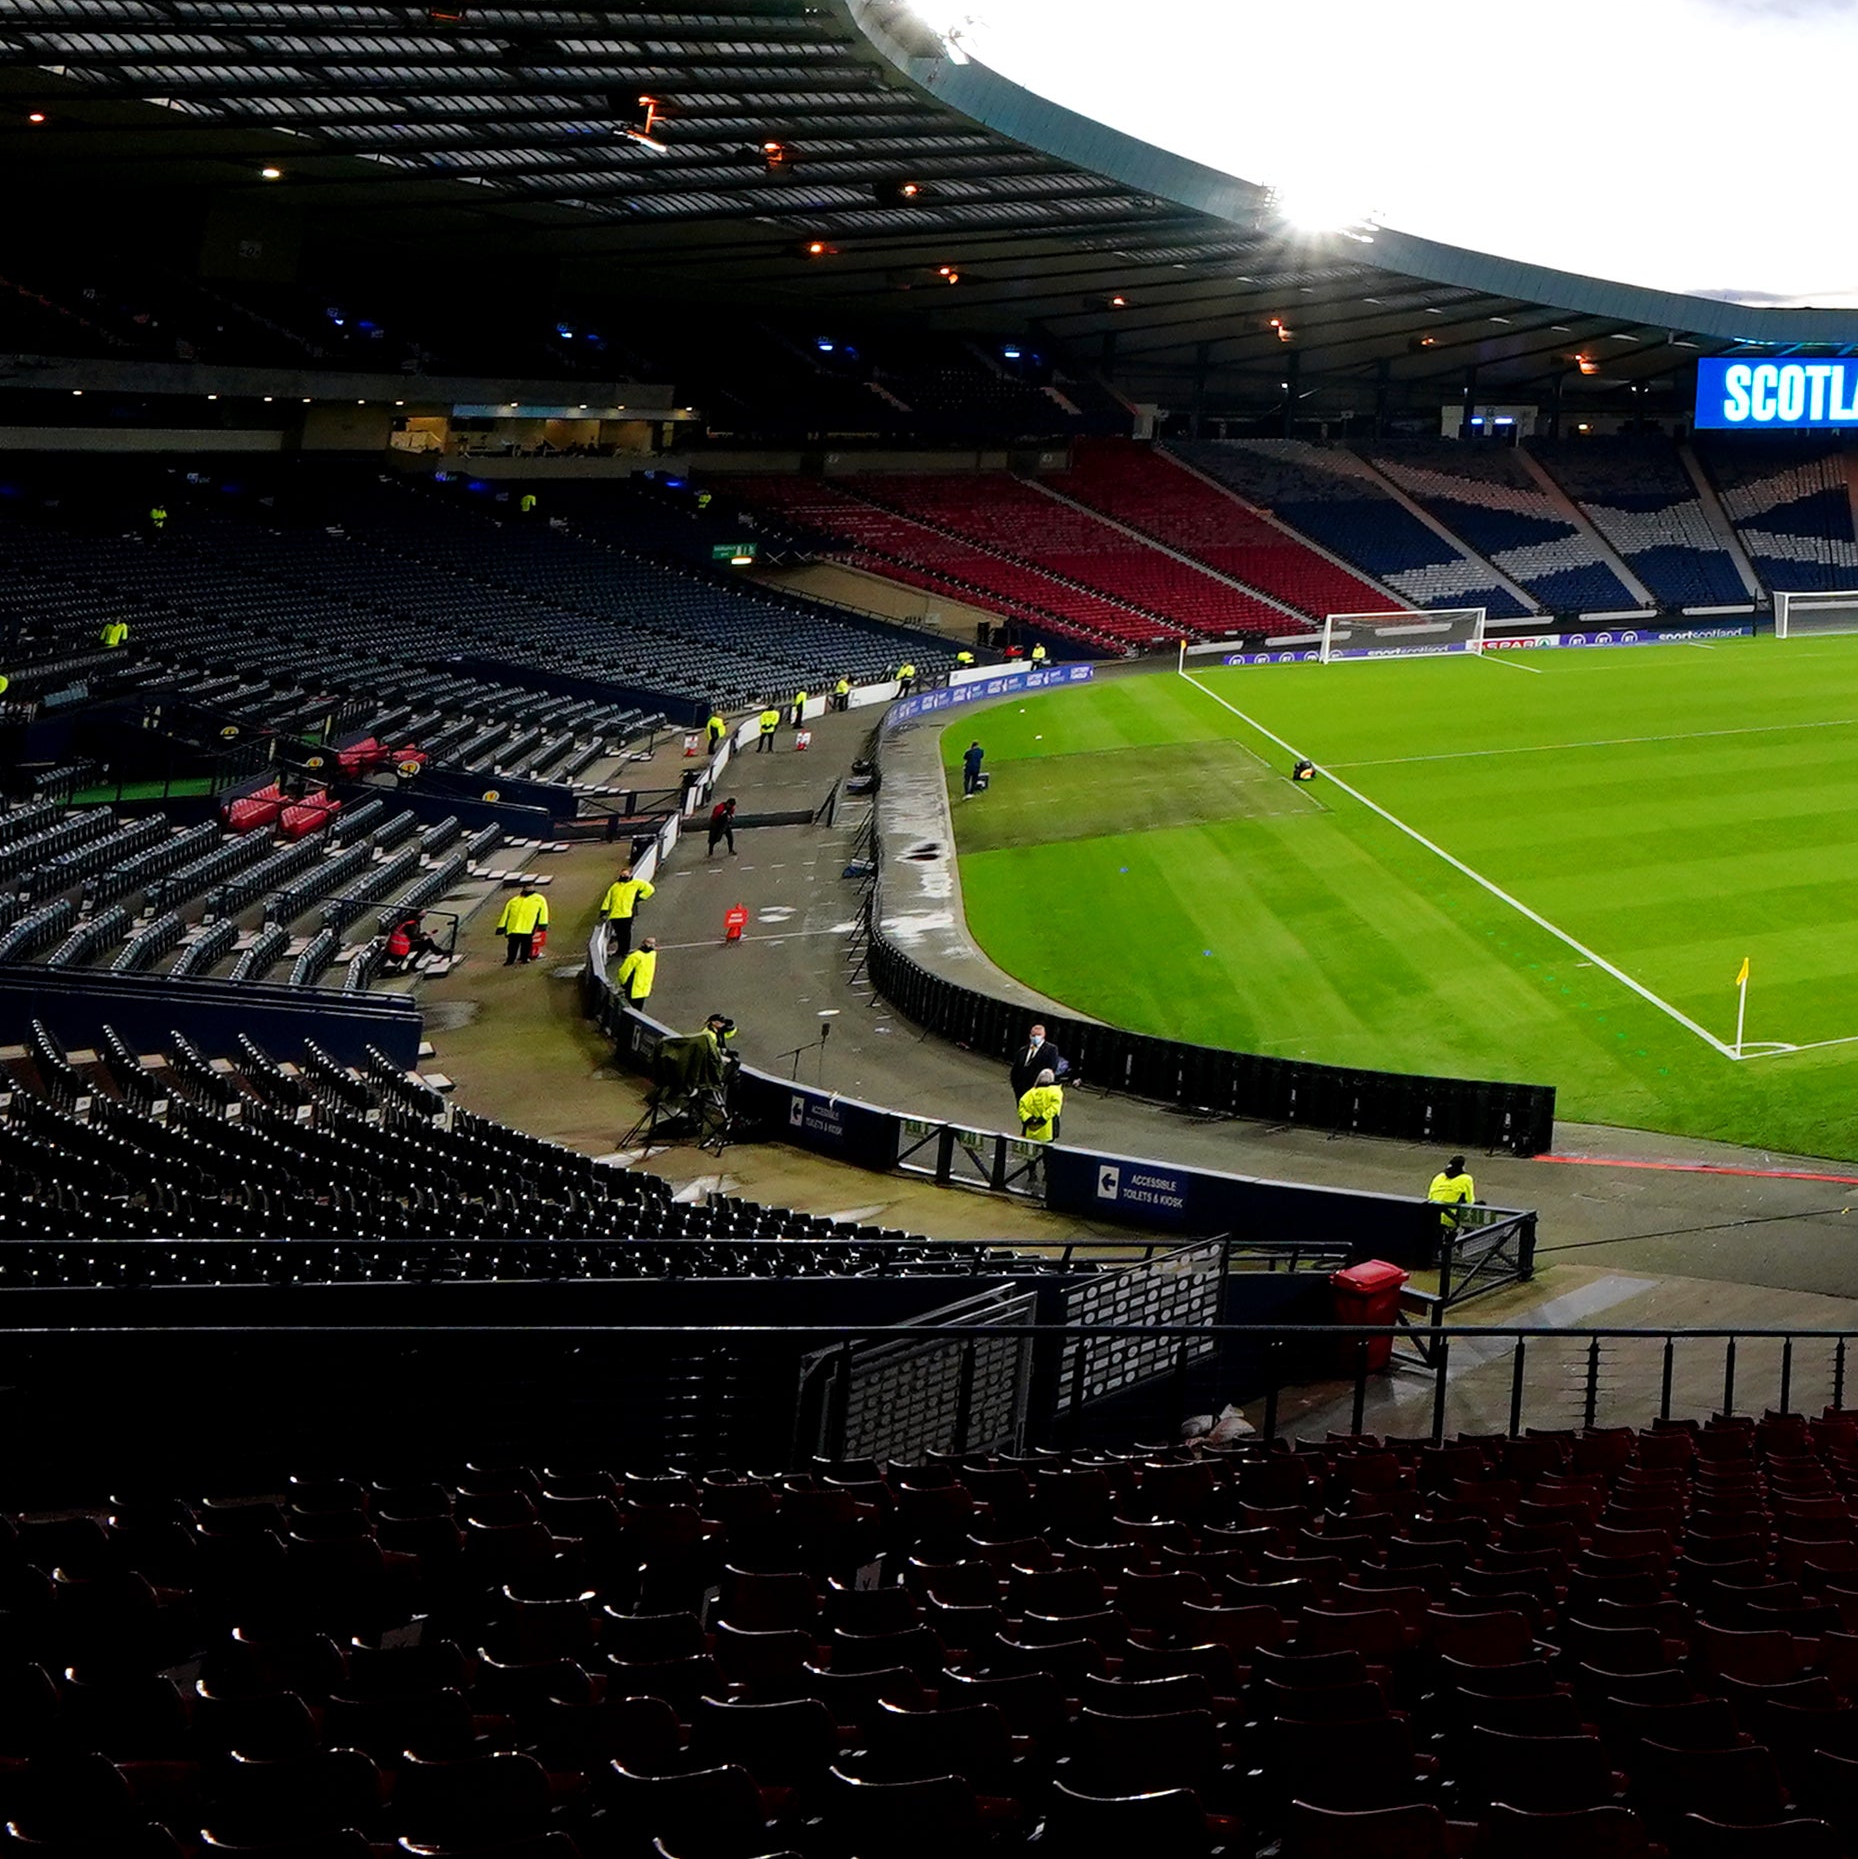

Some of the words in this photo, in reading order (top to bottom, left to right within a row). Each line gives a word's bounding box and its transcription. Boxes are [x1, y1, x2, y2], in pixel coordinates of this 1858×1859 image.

[1131, 1174, 1177, 1192] ACCESSIBLE
[1122, 1188, 1152, 1203] TOILETS
[1160, 1194, 1184, 1210] KIOSK
